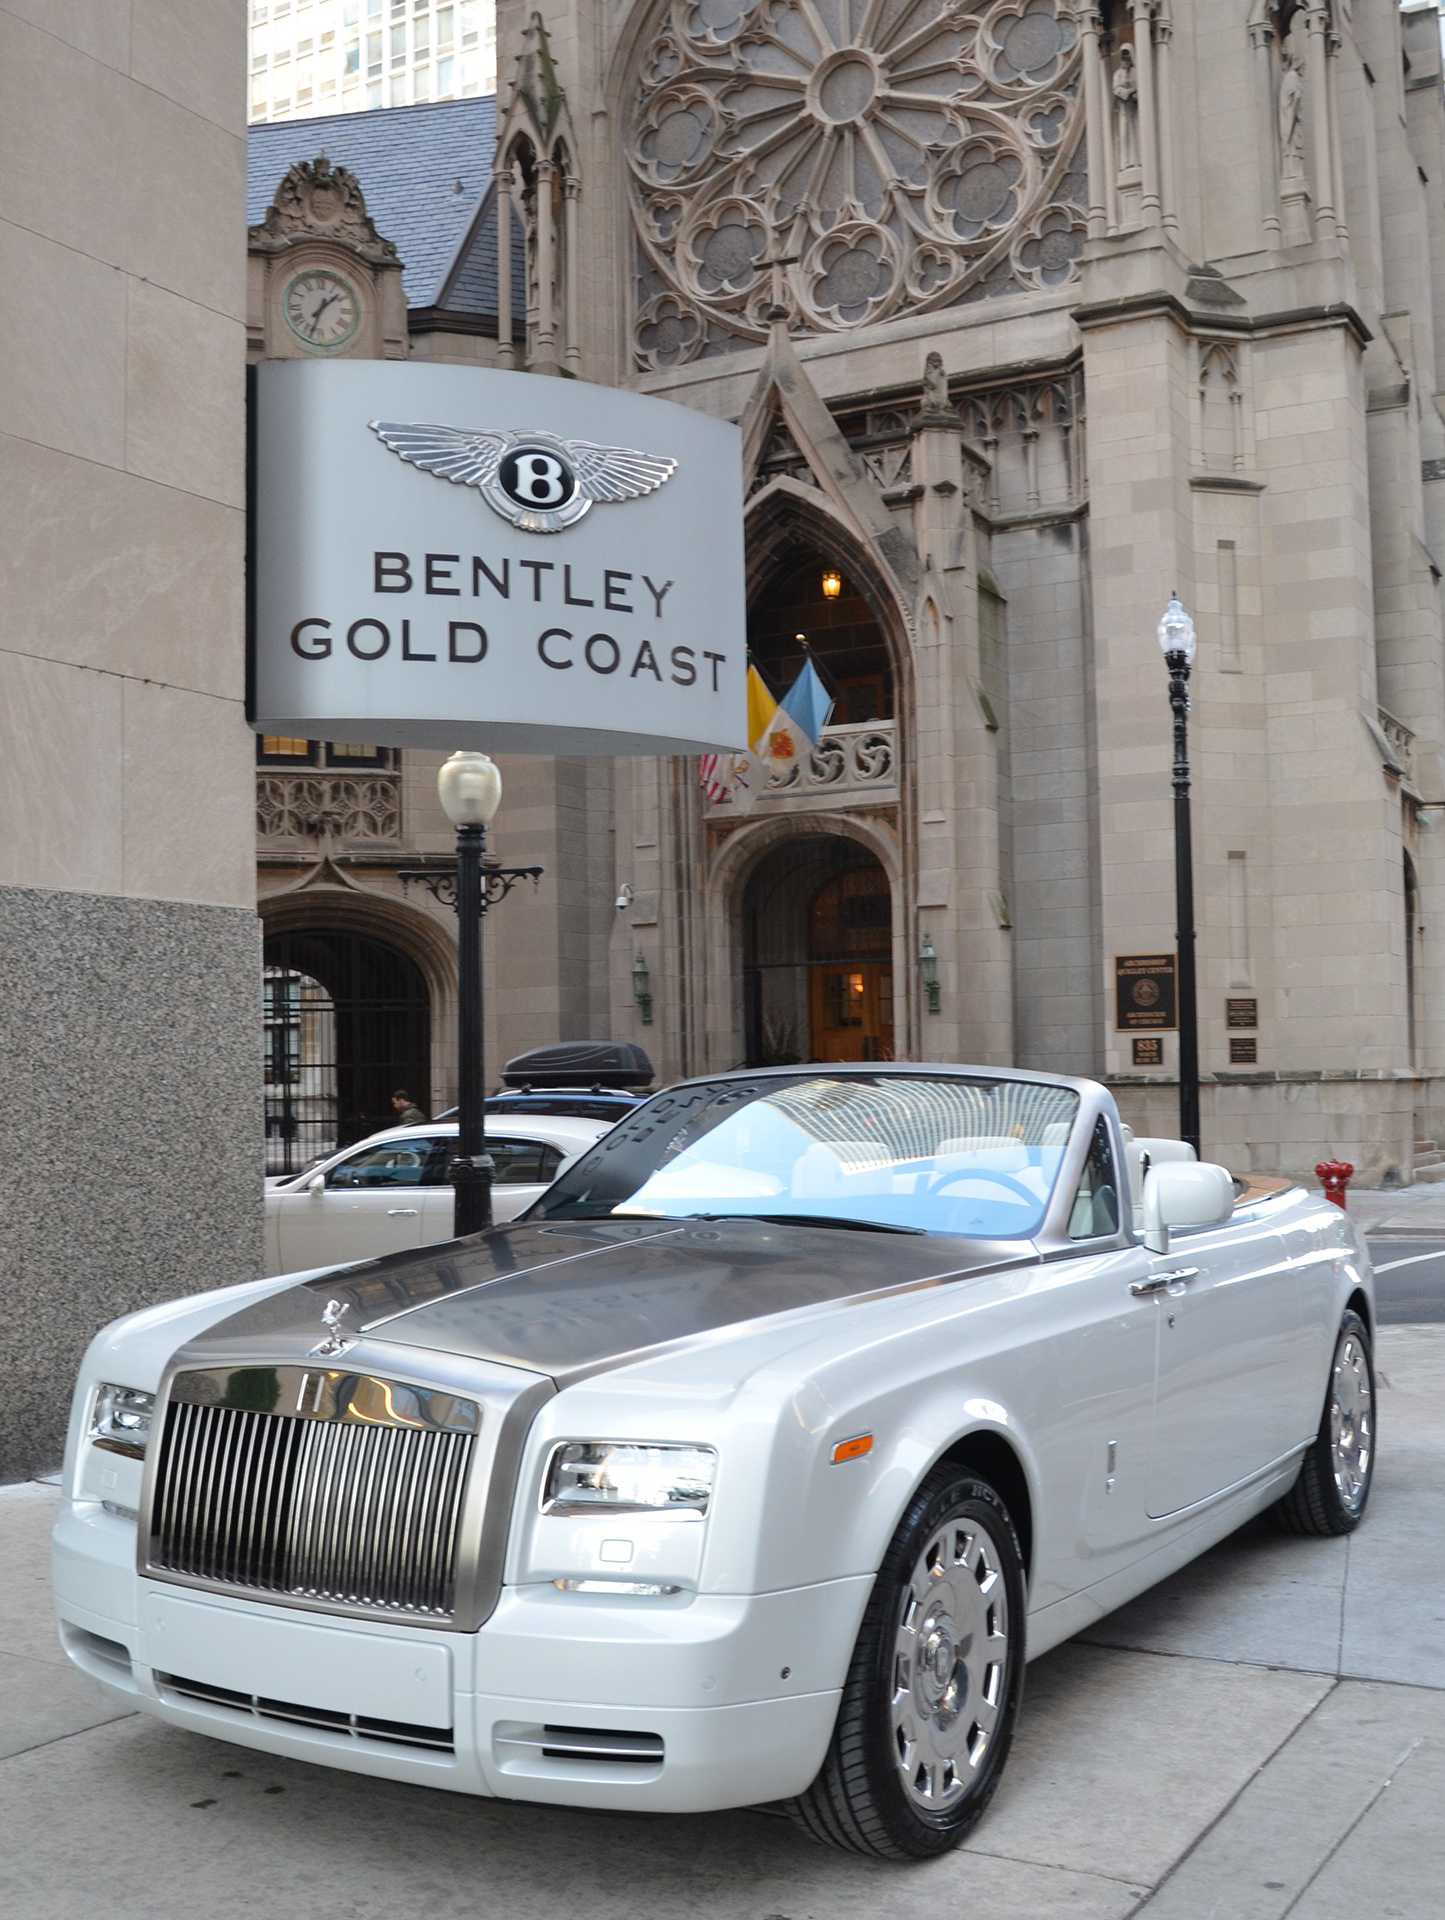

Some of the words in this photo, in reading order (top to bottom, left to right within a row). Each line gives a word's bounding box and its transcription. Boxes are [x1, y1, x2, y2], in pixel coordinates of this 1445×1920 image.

[514, 454, 564, 504] B
[374, 551, 674, 617] BENTLEY
[289, 617, 488, 663] GOLD
[537, 628, 726, 692] COAST
